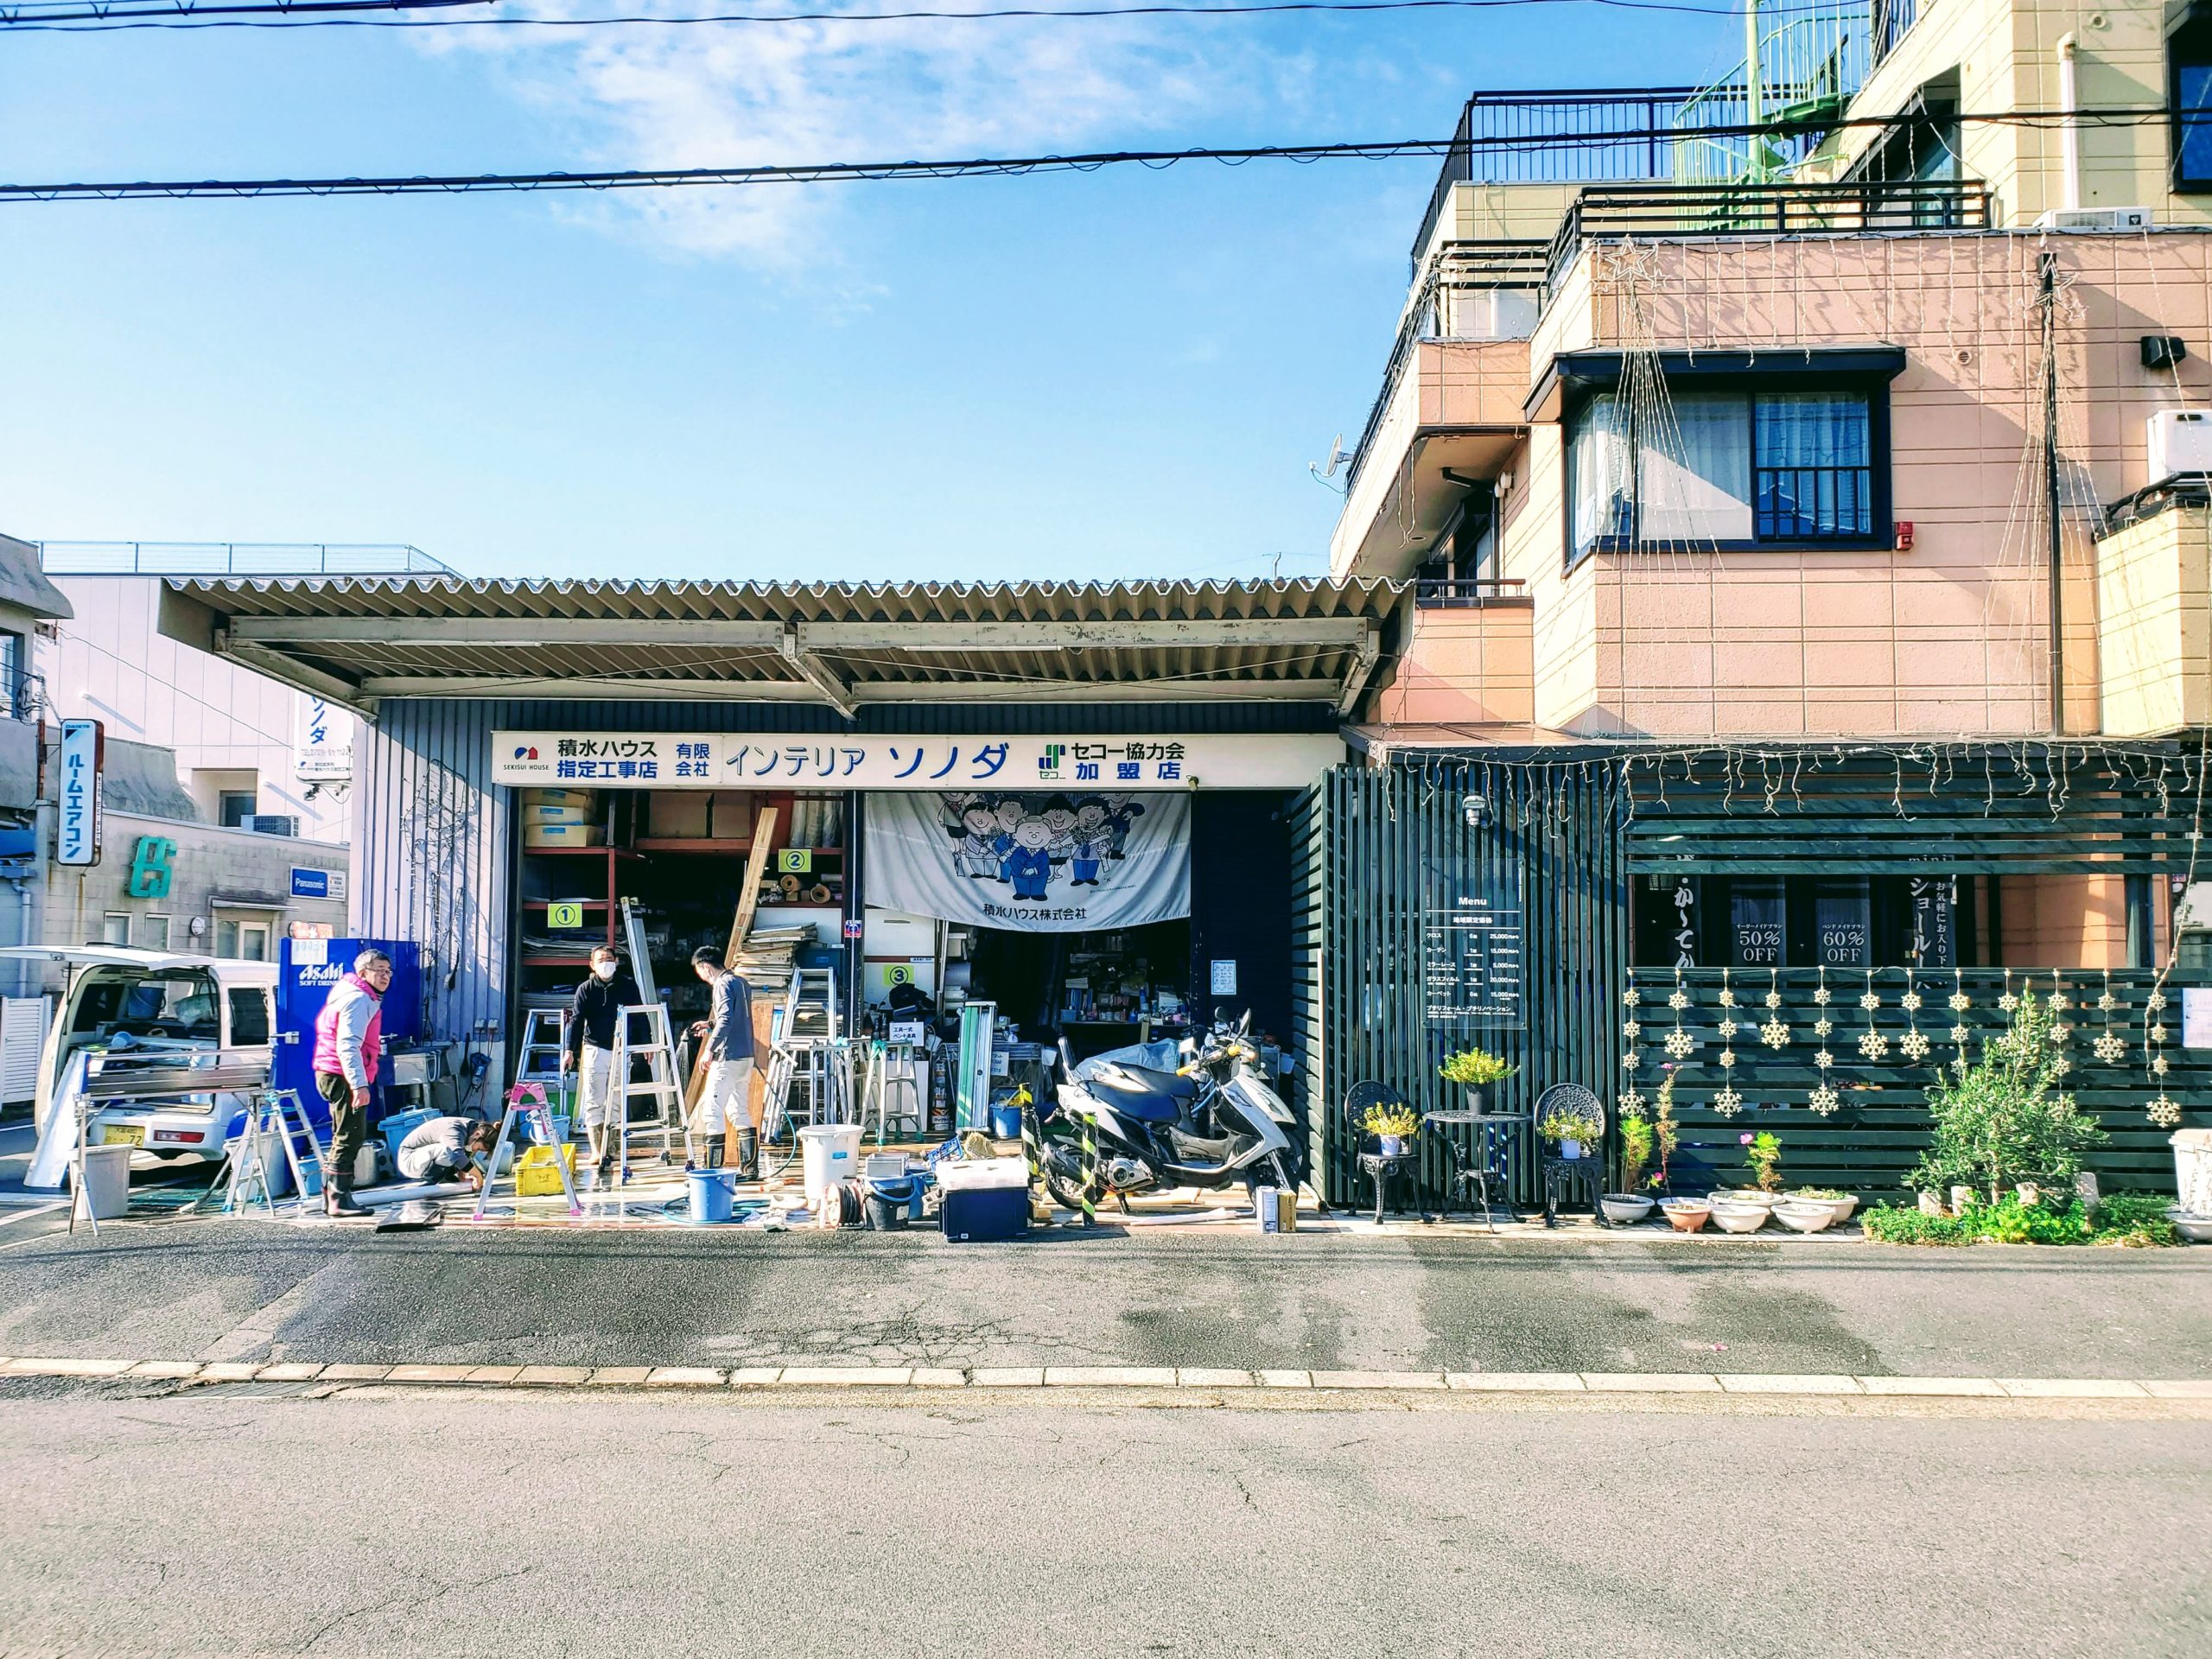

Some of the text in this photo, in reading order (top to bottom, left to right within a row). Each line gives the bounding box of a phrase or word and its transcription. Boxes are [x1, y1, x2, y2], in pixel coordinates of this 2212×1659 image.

[558, 740, 658, 757] 積水ハウス
[676, 743, 710, 760] 有限
[1071, 742, 1185, 760] セコー協力会
[676, 761, 709, 777] 会社
[727, 742, 1010, 779] インテリア ソノダ
[557, 760, 658, 779] 指定工事店
[1076, 762, 1181, 779] 加盟店
[65, 753, 85, 858] ルームエアコン
[296, 878, 325, 889] Panasonic
[1459, 897, 1487, 906] Menu
[983, 904, 1087, 920] 積水ハウス株式会社
[1739, 931, 1781, 946] 50%
[1823, 931, 1865, 946] 60%
[1936, 881, 1948, 985] お気軽にお入り下
[1743, 948, 1777, 961] OFF
[1827, 949, 1861, 962] OFF
[299, 962, 344, 980] Asahi
